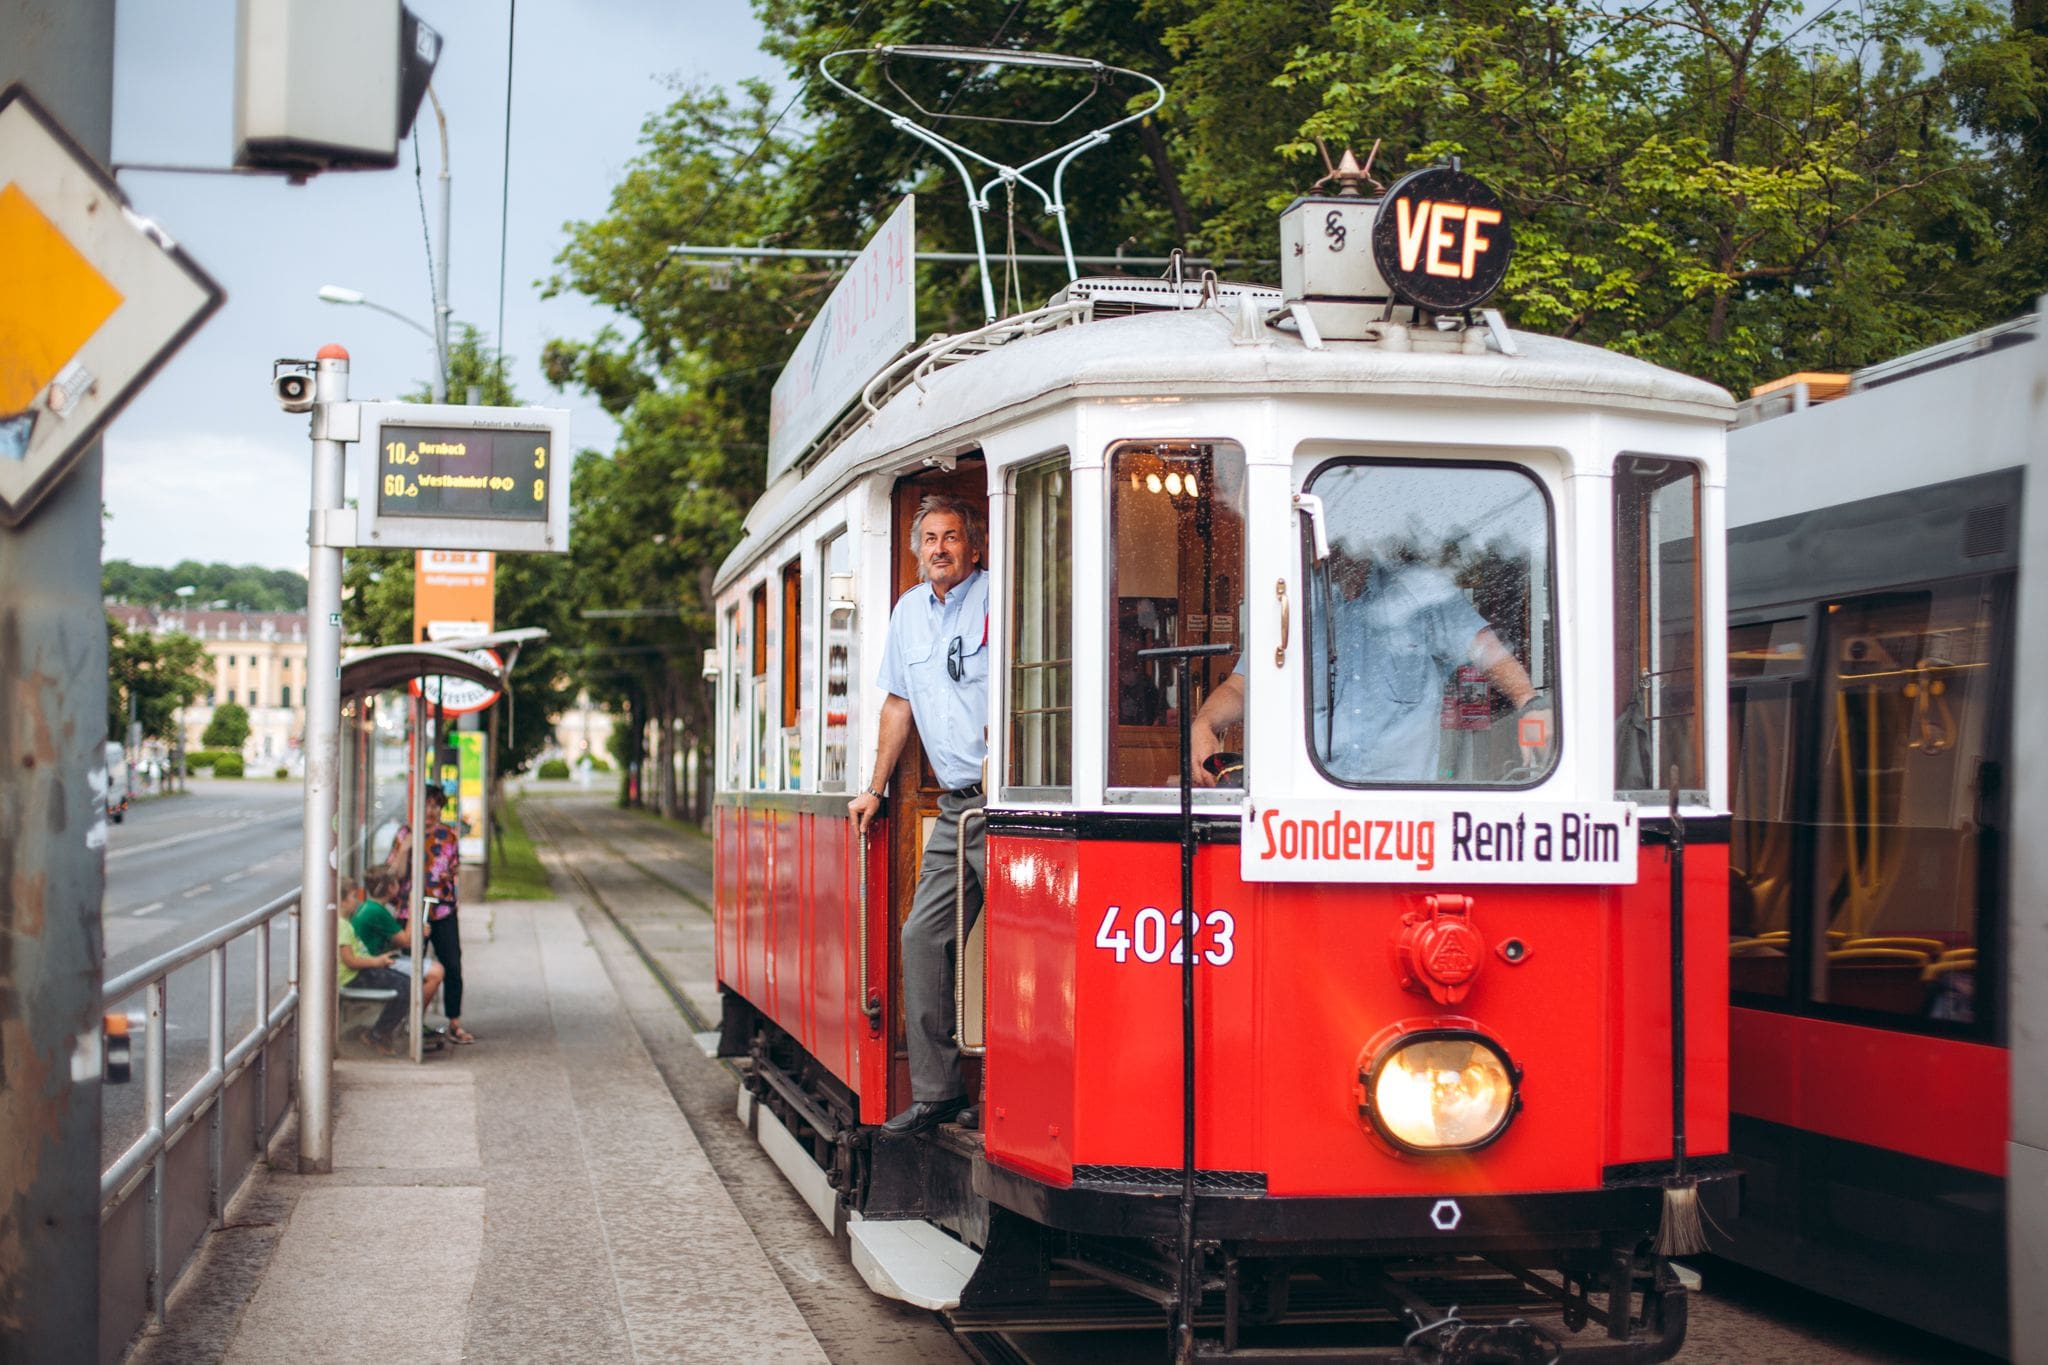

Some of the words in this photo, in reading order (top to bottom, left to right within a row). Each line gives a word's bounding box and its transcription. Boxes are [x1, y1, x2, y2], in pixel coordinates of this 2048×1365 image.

[1396, 196, 1502, 280] VEF
[386, 442, 406, 465] 10
[418, 442, 466, 456] Dornbach
[534, 446, 546, 469] 3
[384, 473, 405, 496] 60
[417, 474, 488, 489] Westbahnhof
[533, 478, 545, 501] 8
[1260, 808, 1435, 872] Sonderzug
[1452, 811, 1525, 863] Rent
[1534, 821, 1553, 863] a
[1561, 811, 1620, 863] Bim
[1095, 906, 1236, 966] 4023
